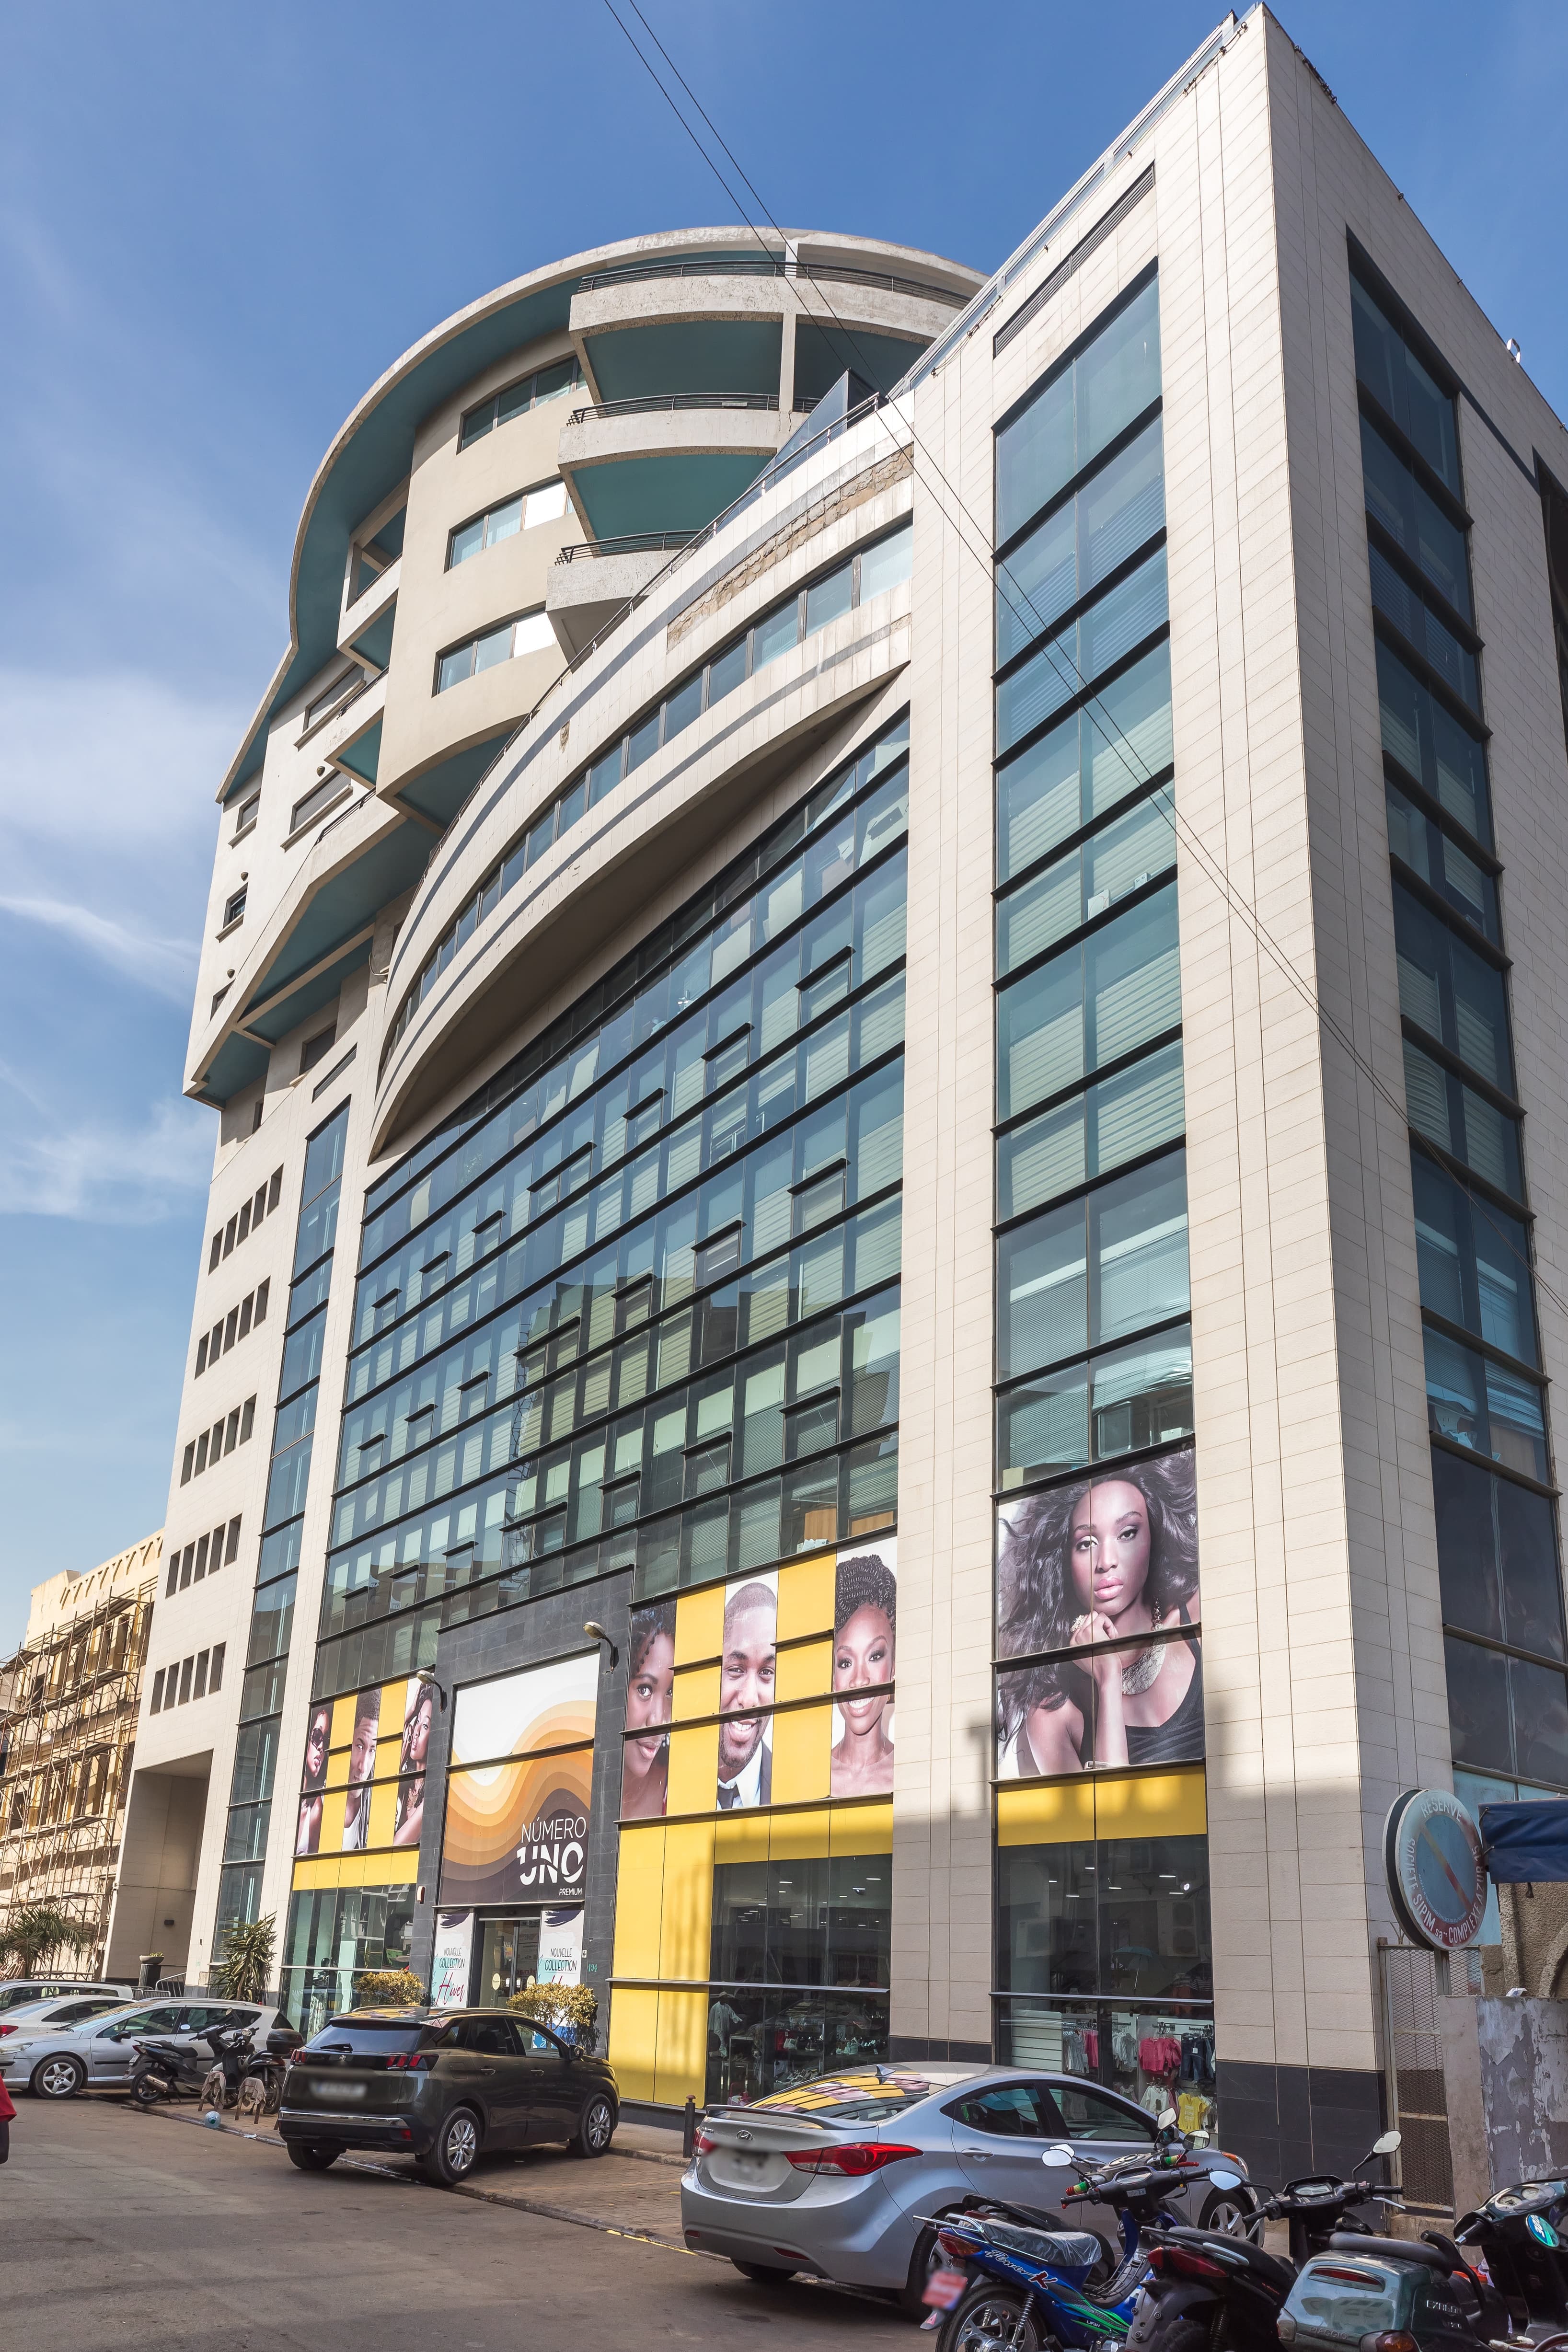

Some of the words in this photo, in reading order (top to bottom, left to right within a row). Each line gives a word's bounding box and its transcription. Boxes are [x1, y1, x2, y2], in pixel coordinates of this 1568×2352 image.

[521, 1816, 587, 1843] NÚMERO
[517, 1842, 584, 1885] UNO
[559, 1888, 582, 1896] PREMIUM
[1413, 1893, 1436, 1931] SIPIM
[444, 1947, 462, 1956] NOUVELLE
[551, 1948, 573, 1957] NOUVELLE
[439, 1958, 465, 1968] COLLECTION
[544, 1960, 577, 1972] COLLECTION
[588, 1963, 598, 1972] 194
[435, 1972, 465, 2006] Hiver
[1311, 2327, 1347, 2340] PIAGGIO
